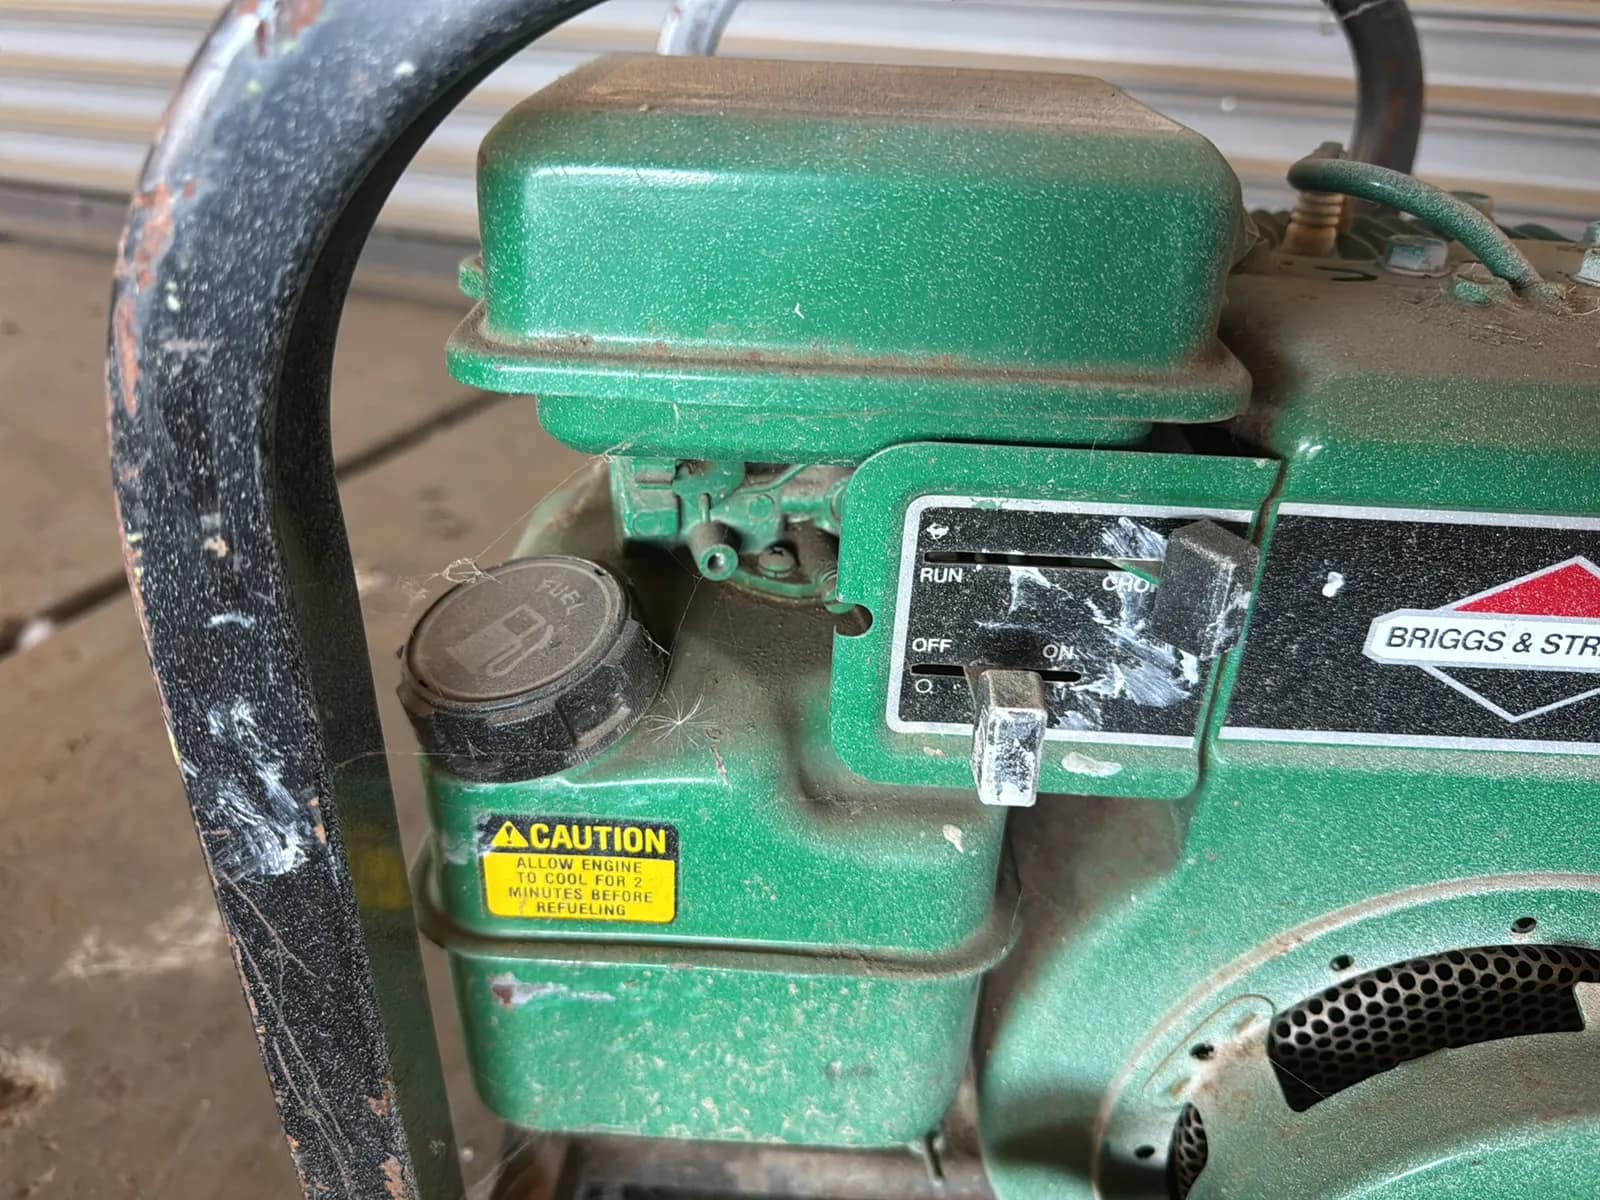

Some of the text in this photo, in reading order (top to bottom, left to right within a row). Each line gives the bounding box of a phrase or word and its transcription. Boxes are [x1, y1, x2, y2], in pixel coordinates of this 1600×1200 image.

[920, 568, 963, 583] RUN
[1102, 576, 1156, 593] CHO
[536, 579, 585, 616] FUEL
[912, 638, 952, 653] OFF
[1385, 626, 1600, 656] BRIGGS & STR
[1043, 644, 1074, 660] ON
[529, 823, 667, 854] CAUTION
[516, 857, 642, 874] ALLOW ENGINE
[518, 872, 642, 888] TO COOL FOR 2
[509, 888, 653, 903] MINUTES BEFORE
[537, 902, 626, 916] REFUELING
